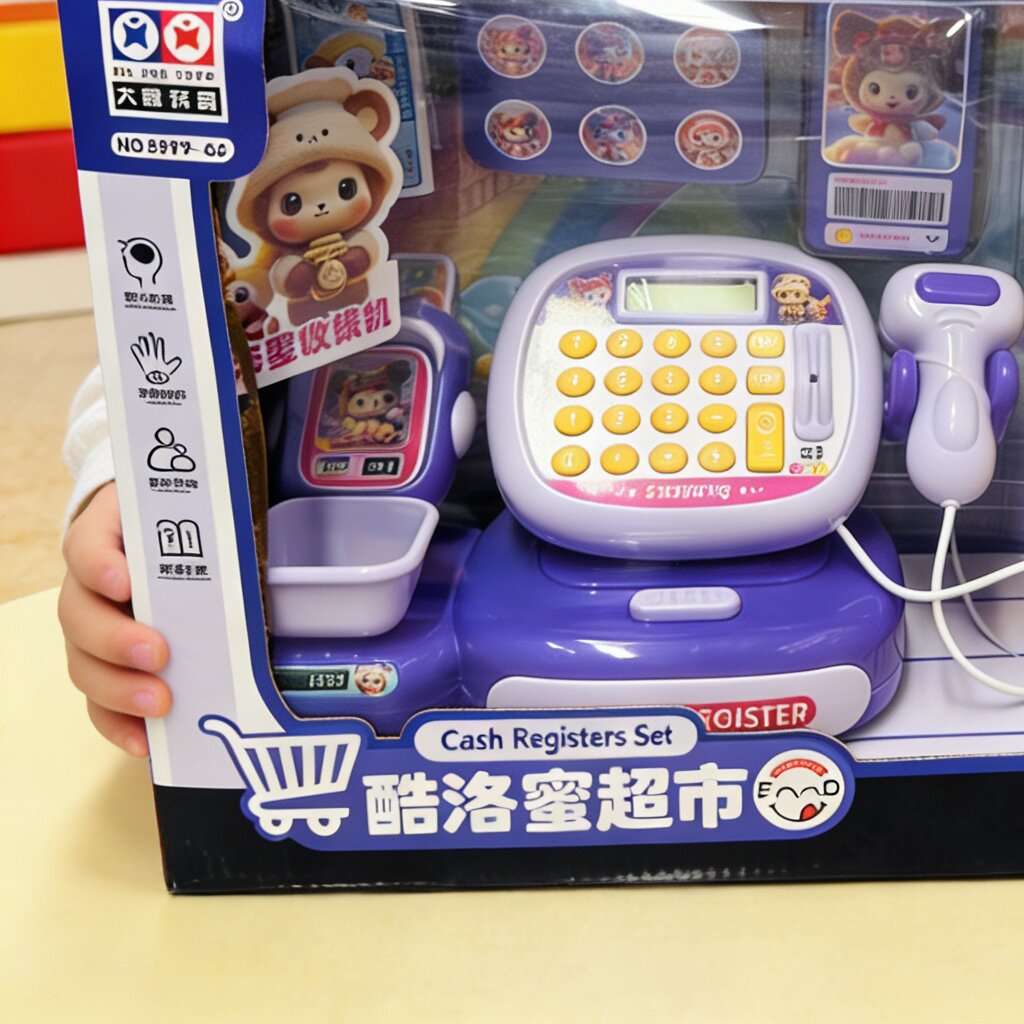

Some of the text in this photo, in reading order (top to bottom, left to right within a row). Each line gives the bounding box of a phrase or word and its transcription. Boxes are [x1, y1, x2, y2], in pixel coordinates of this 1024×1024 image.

[117, 136, 144, 154] NO
[440, 723, 673, 755] Cash Registers Set
[362, 762, 749, 836] 酷洛蜜超市
